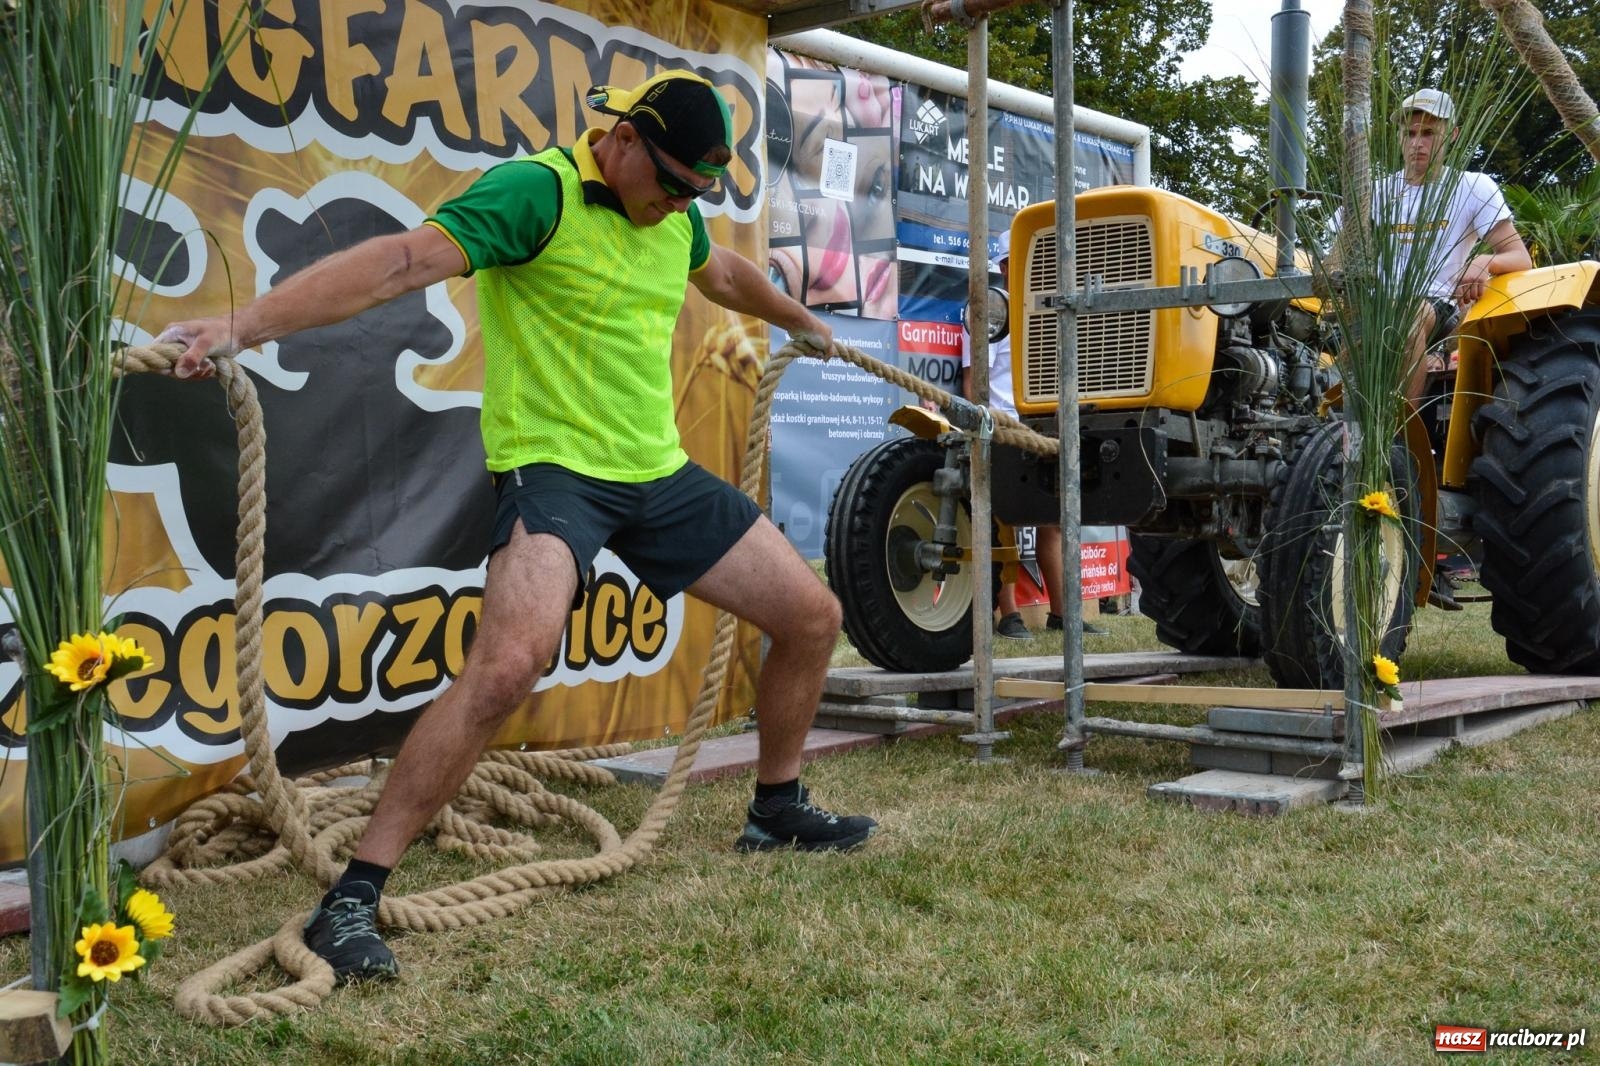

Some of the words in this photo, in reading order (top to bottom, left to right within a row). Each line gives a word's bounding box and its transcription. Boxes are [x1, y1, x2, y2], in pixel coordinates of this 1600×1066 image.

[909, 119, 939, 136] LUKART
[919, 165, 946, 196] NA
[954, 171, 1030, 210] WMIAR
[772, 221, 792, 234] 969
[933, 233, 946, 245] tel.
[948, 235, 961, 247] 516
[821, 371, 846, 383] kruszyw
[862, 395, 884, 405] wykopy
[786, 413, 807, 423] kostki
[807, 414, 840, 426] granitowej
[828, 428, 860, 440] betonowej
